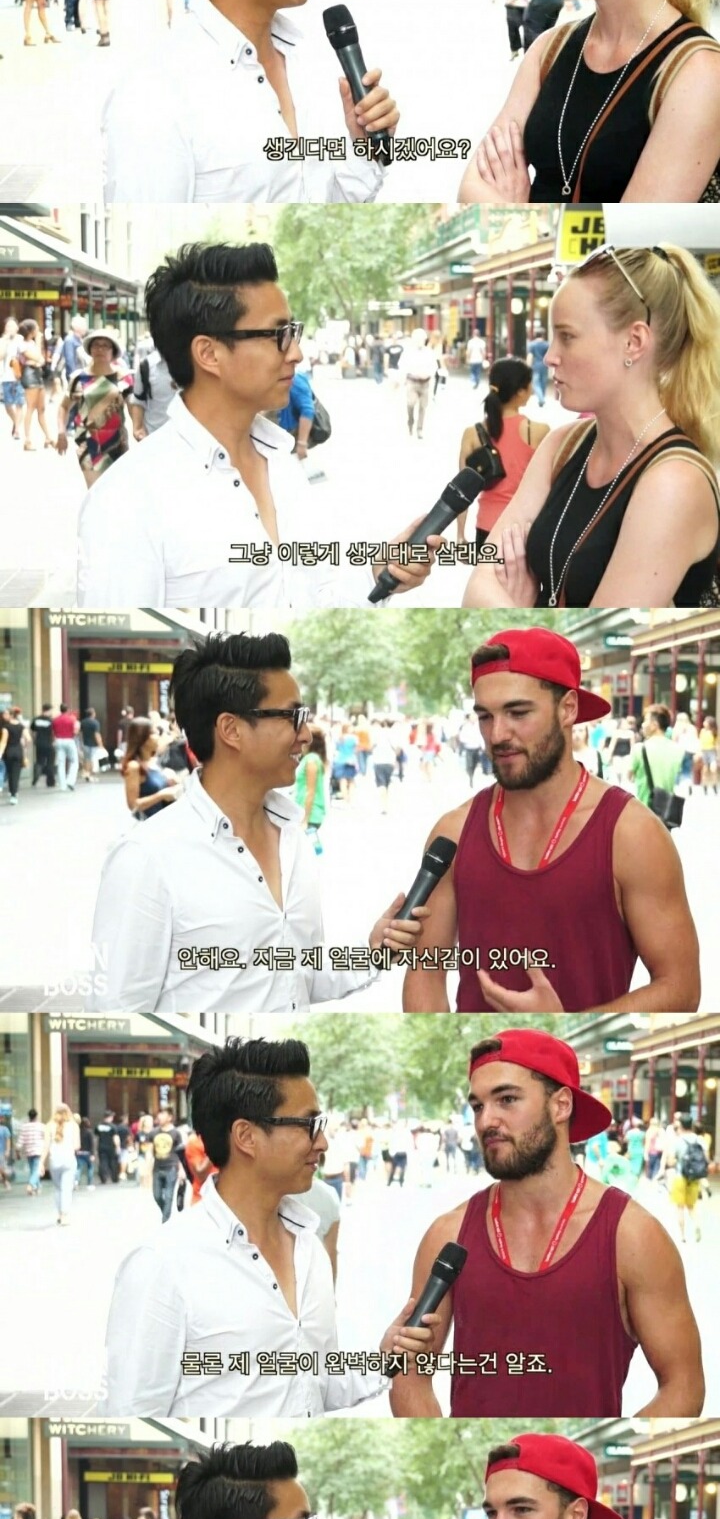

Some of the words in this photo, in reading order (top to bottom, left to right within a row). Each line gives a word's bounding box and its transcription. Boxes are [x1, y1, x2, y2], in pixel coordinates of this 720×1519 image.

[48, 613, 126, 626] WITCHERY
[48, 1018, 126, 1031] WITCHERY
[48, 1423, 126, 1436] WITCHERY
